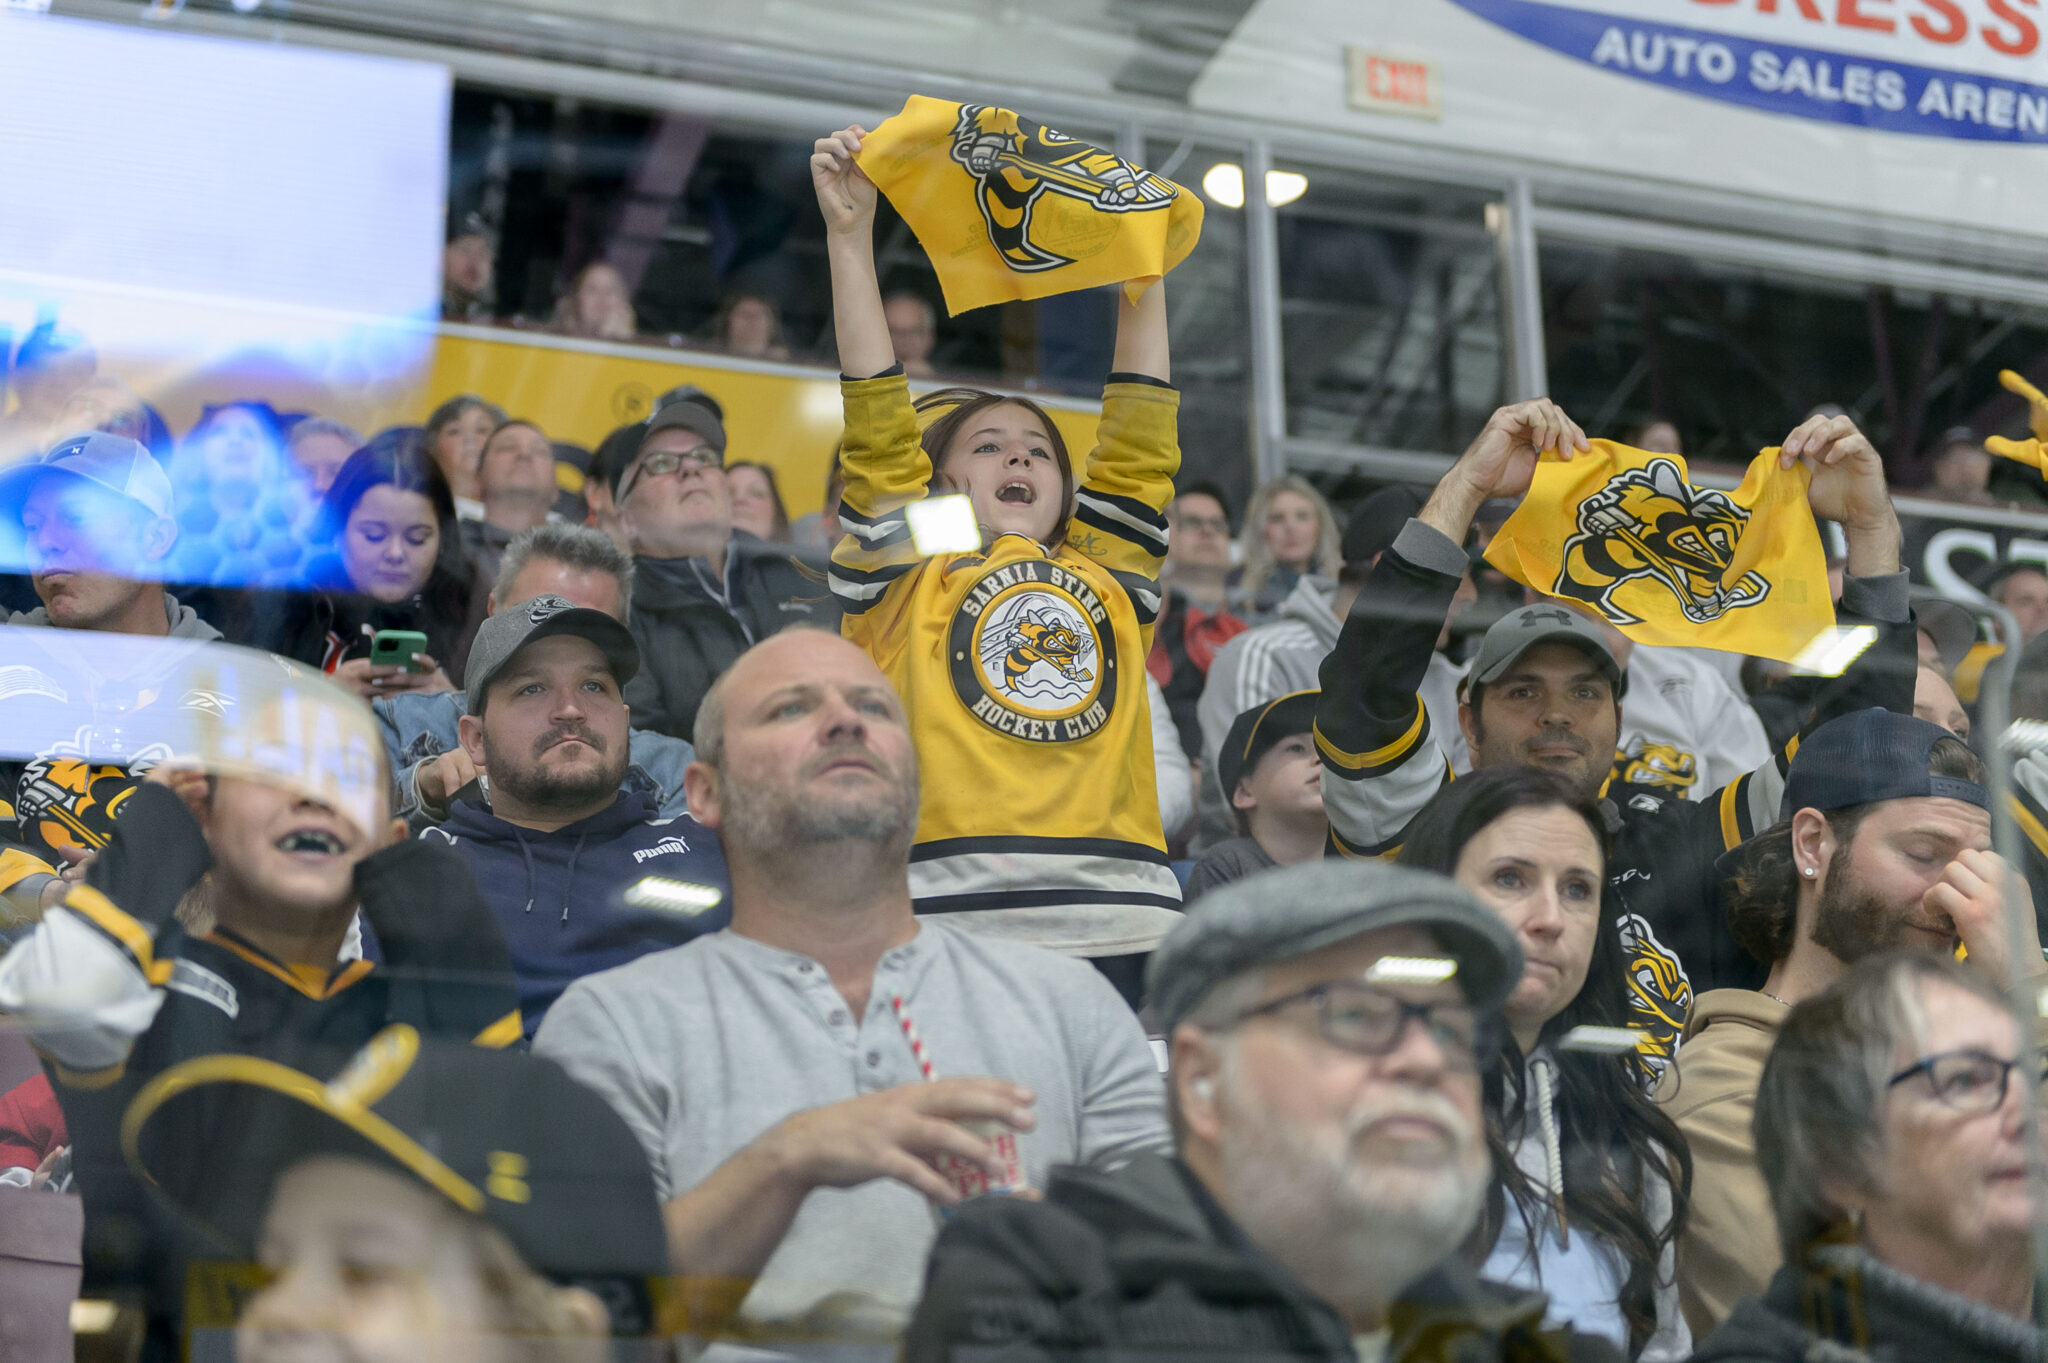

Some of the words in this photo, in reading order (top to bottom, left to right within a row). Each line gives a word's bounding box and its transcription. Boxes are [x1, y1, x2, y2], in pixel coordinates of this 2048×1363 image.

[1592, 26, 1738, 84] AUTO
[1748, 49, 1908, 112] SALES
[1916, 77, 2048, 134] AREN
[962, 563, 1038, 617] SARNIA
[1051, 567, 1106, 624] STING
[972, 694, 1057, 740] HOCKEY
[1064, 701, 1107, 739] CLUB
[632, 841, 685, 864] PUMA
